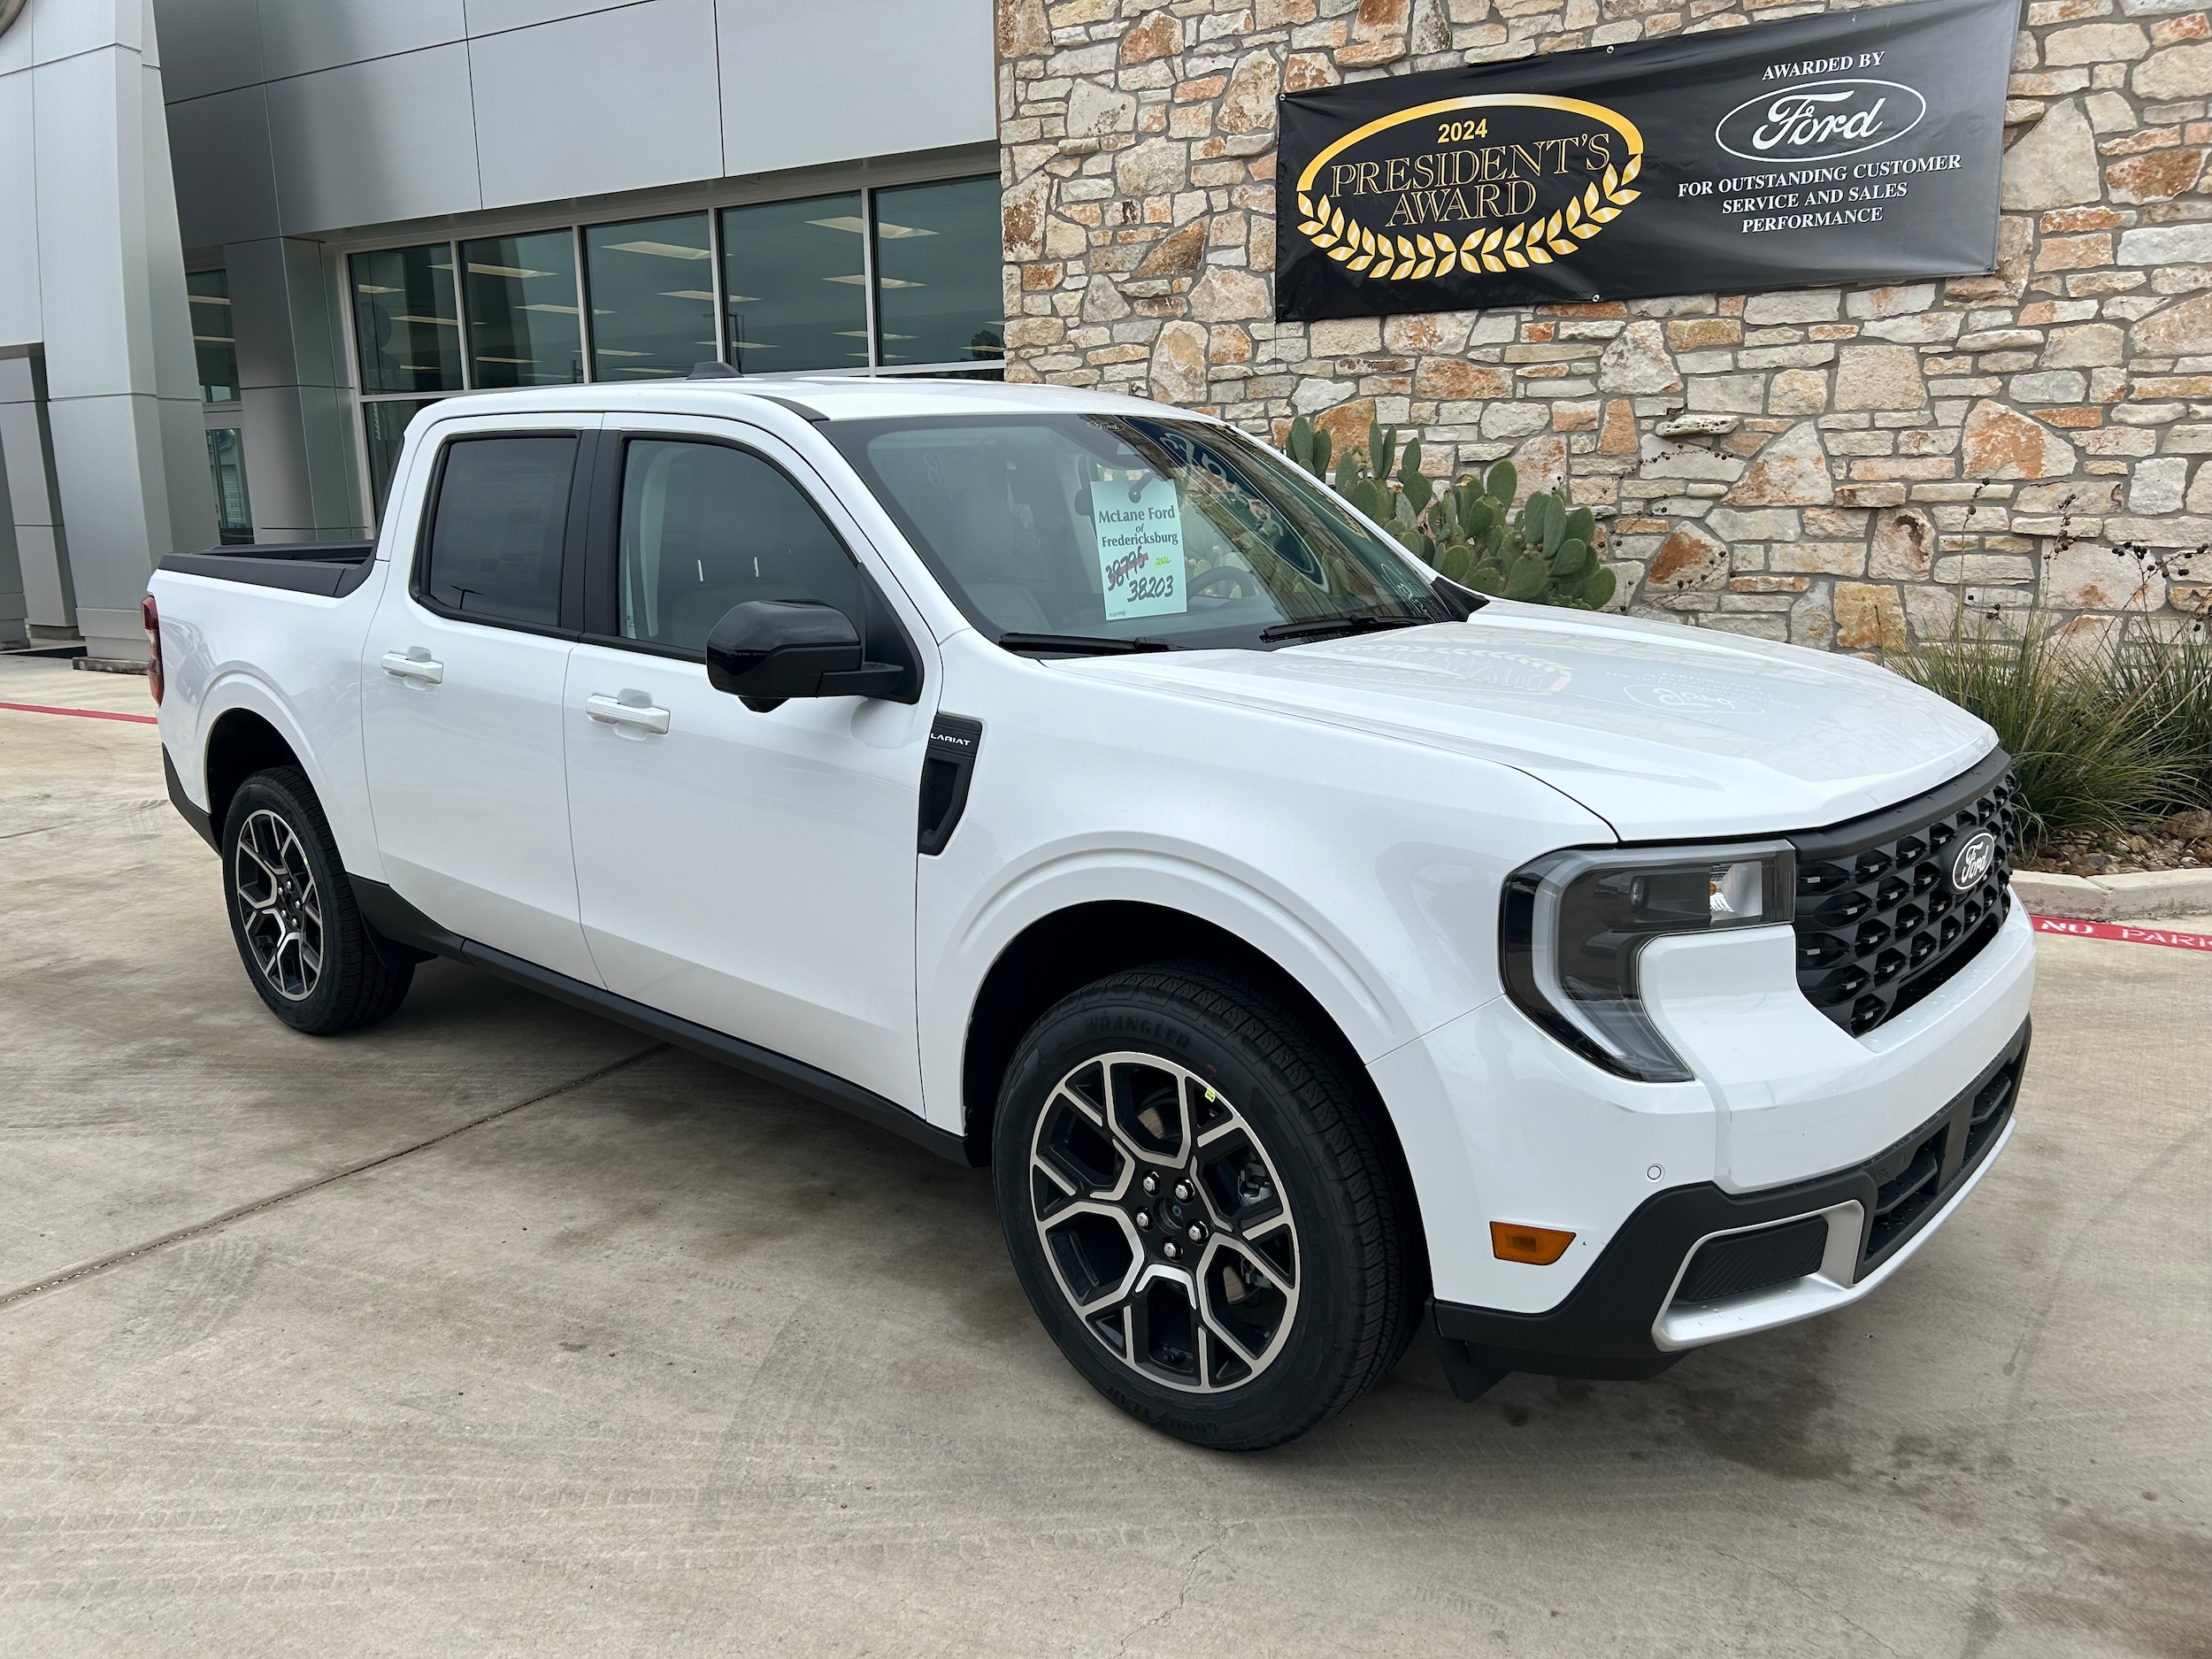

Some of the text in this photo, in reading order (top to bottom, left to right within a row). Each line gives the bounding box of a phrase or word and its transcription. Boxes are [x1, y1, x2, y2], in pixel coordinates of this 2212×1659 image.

[1762, 51, 1886, 81] AWARDED BY
[1437, 118, 1488, 143] 2024
[1752, 89, 1886, 150] Ford
[1329, 132, 1611, 199] PRESIDENT'S
[1678, 154, 1962, 197] FOR OUTSTANDING CUSTOMER
[1385, 180, 1537, 228] AWARD
[1722, 181, 1909, 214] SERVICE AND SALES
[1741, 206, 1884, 234] PERFORMANCE
[1099, 505, 1176, 524] McLane Ford
[1135, 523, 1145, 534] of
[1102, 532, 1179, 548] Fredericksburg
[1127, 575, 1174, 603] 38203
[930, 733, 972, 746] LARIAT
[1961, 841, 1989, 884] Ford
[2040, 919, 2093, 934] NO
[1084, 1016, 1192, 1049] WRANGLER
